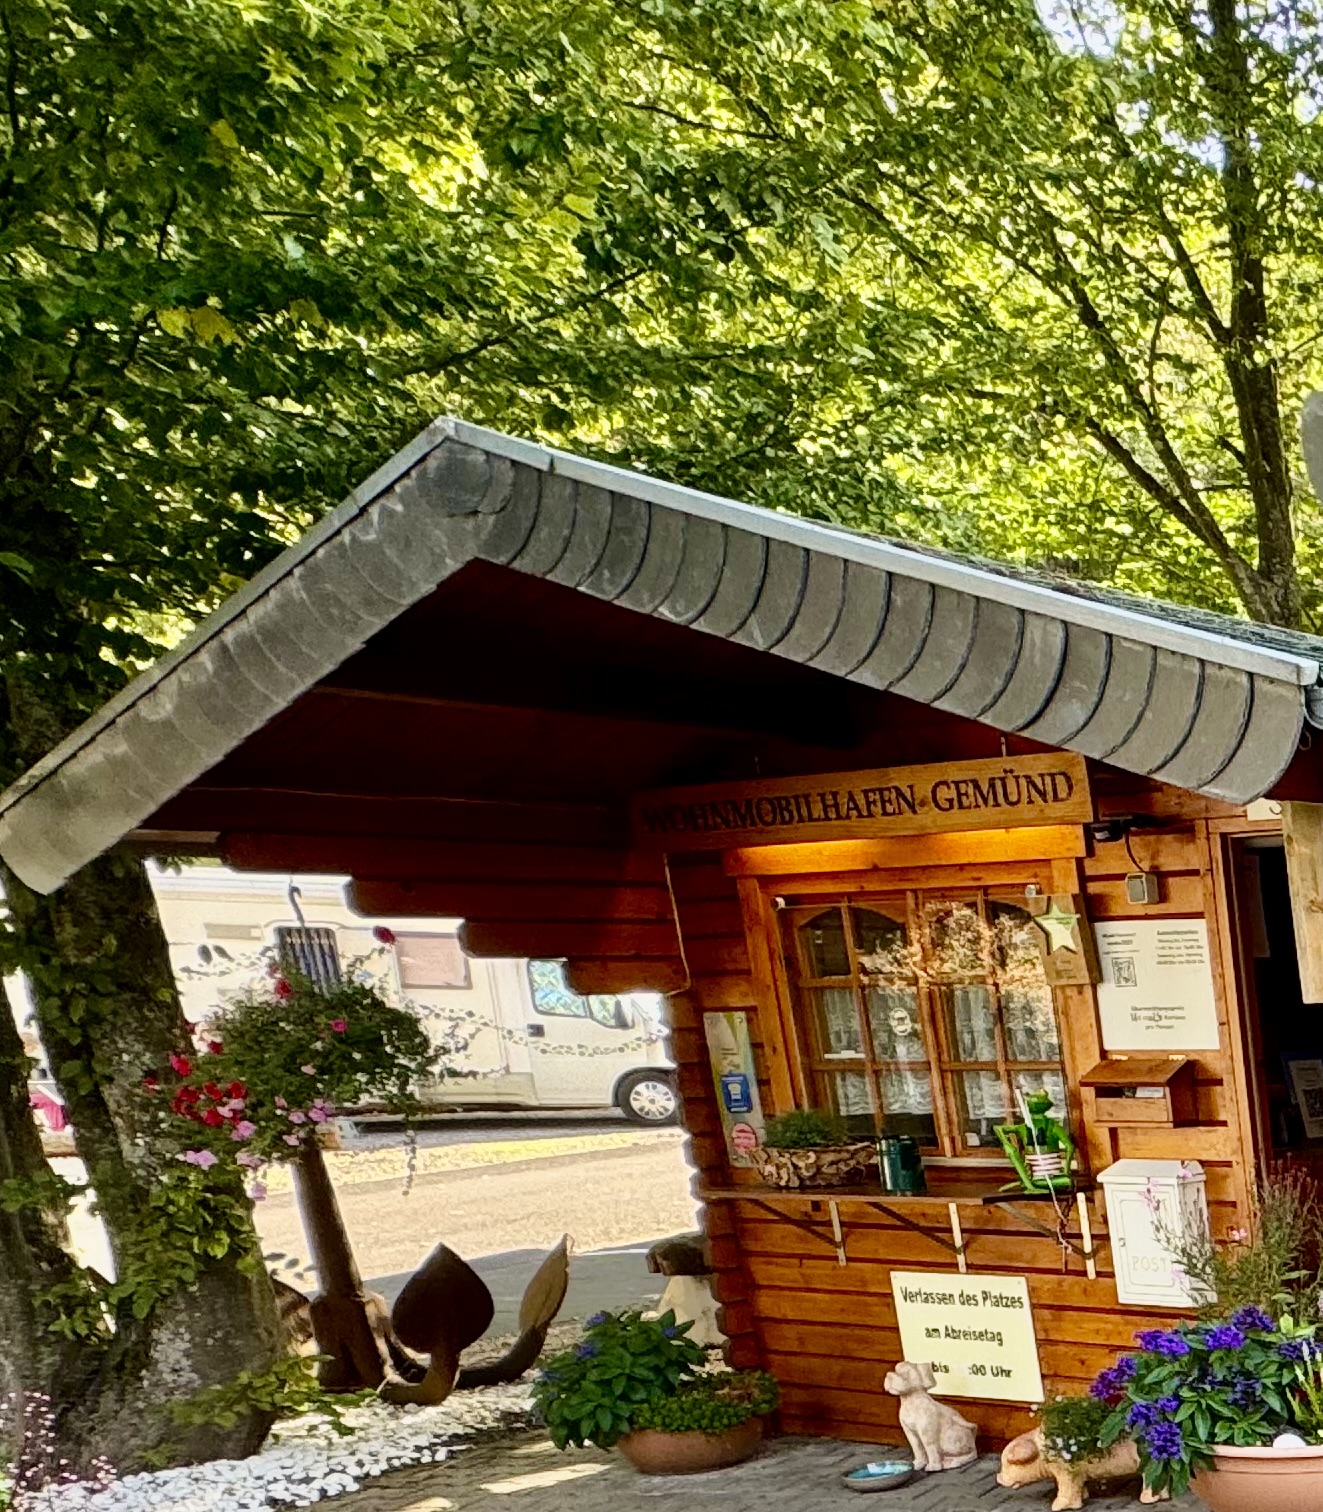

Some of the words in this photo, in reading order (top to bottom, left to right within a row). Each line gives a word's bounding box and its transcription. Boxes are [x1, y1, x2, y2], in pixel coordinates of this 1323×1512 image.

[641, 784, 918, 833] WOHNMOBILHAFEN
[930, 768, 1074, 812] GEMÜND
[1132, 1256, 1168, 1272] POST
[900, 1286, 955, 1305] Verlassen
[958, 1289, 978, 1306] des
[981, 1290, 1024, 1309] Platzes
[925, 1327, 941, 1339] am
[944, 1325, 1004, 1347] Abreisetag
[931, 1361, 950, 1374] bis
[991, 1365, 1013, 1378] Uhr
